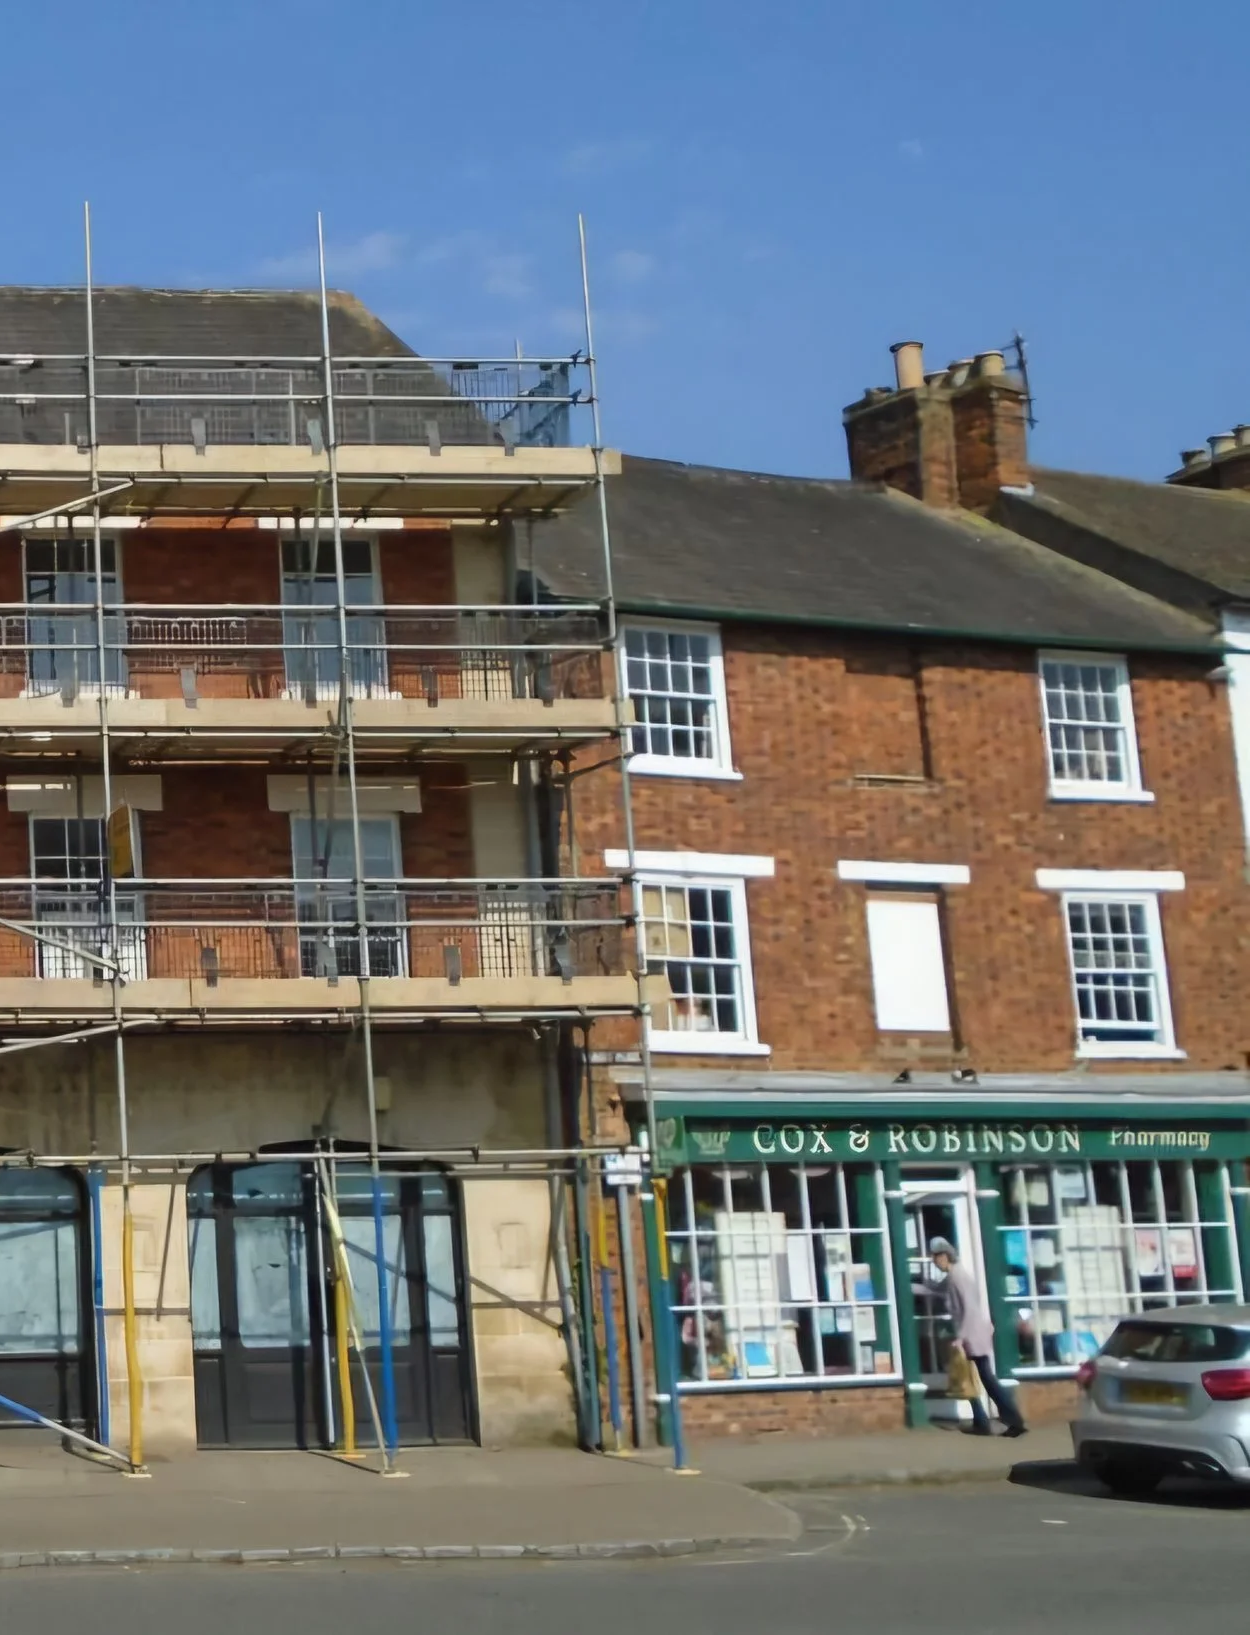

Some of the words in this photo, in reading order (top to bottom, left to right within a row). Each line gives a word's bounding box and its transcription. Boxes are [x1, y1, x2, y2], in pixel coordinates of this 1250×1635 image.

[753, 1124, 833, 1153] COX
[849, 1123, 870, 1153] &
[887, 1123, 1081, 1153] ROBINSON
[1110, 1127, 1211, 1152] Pharmacy
